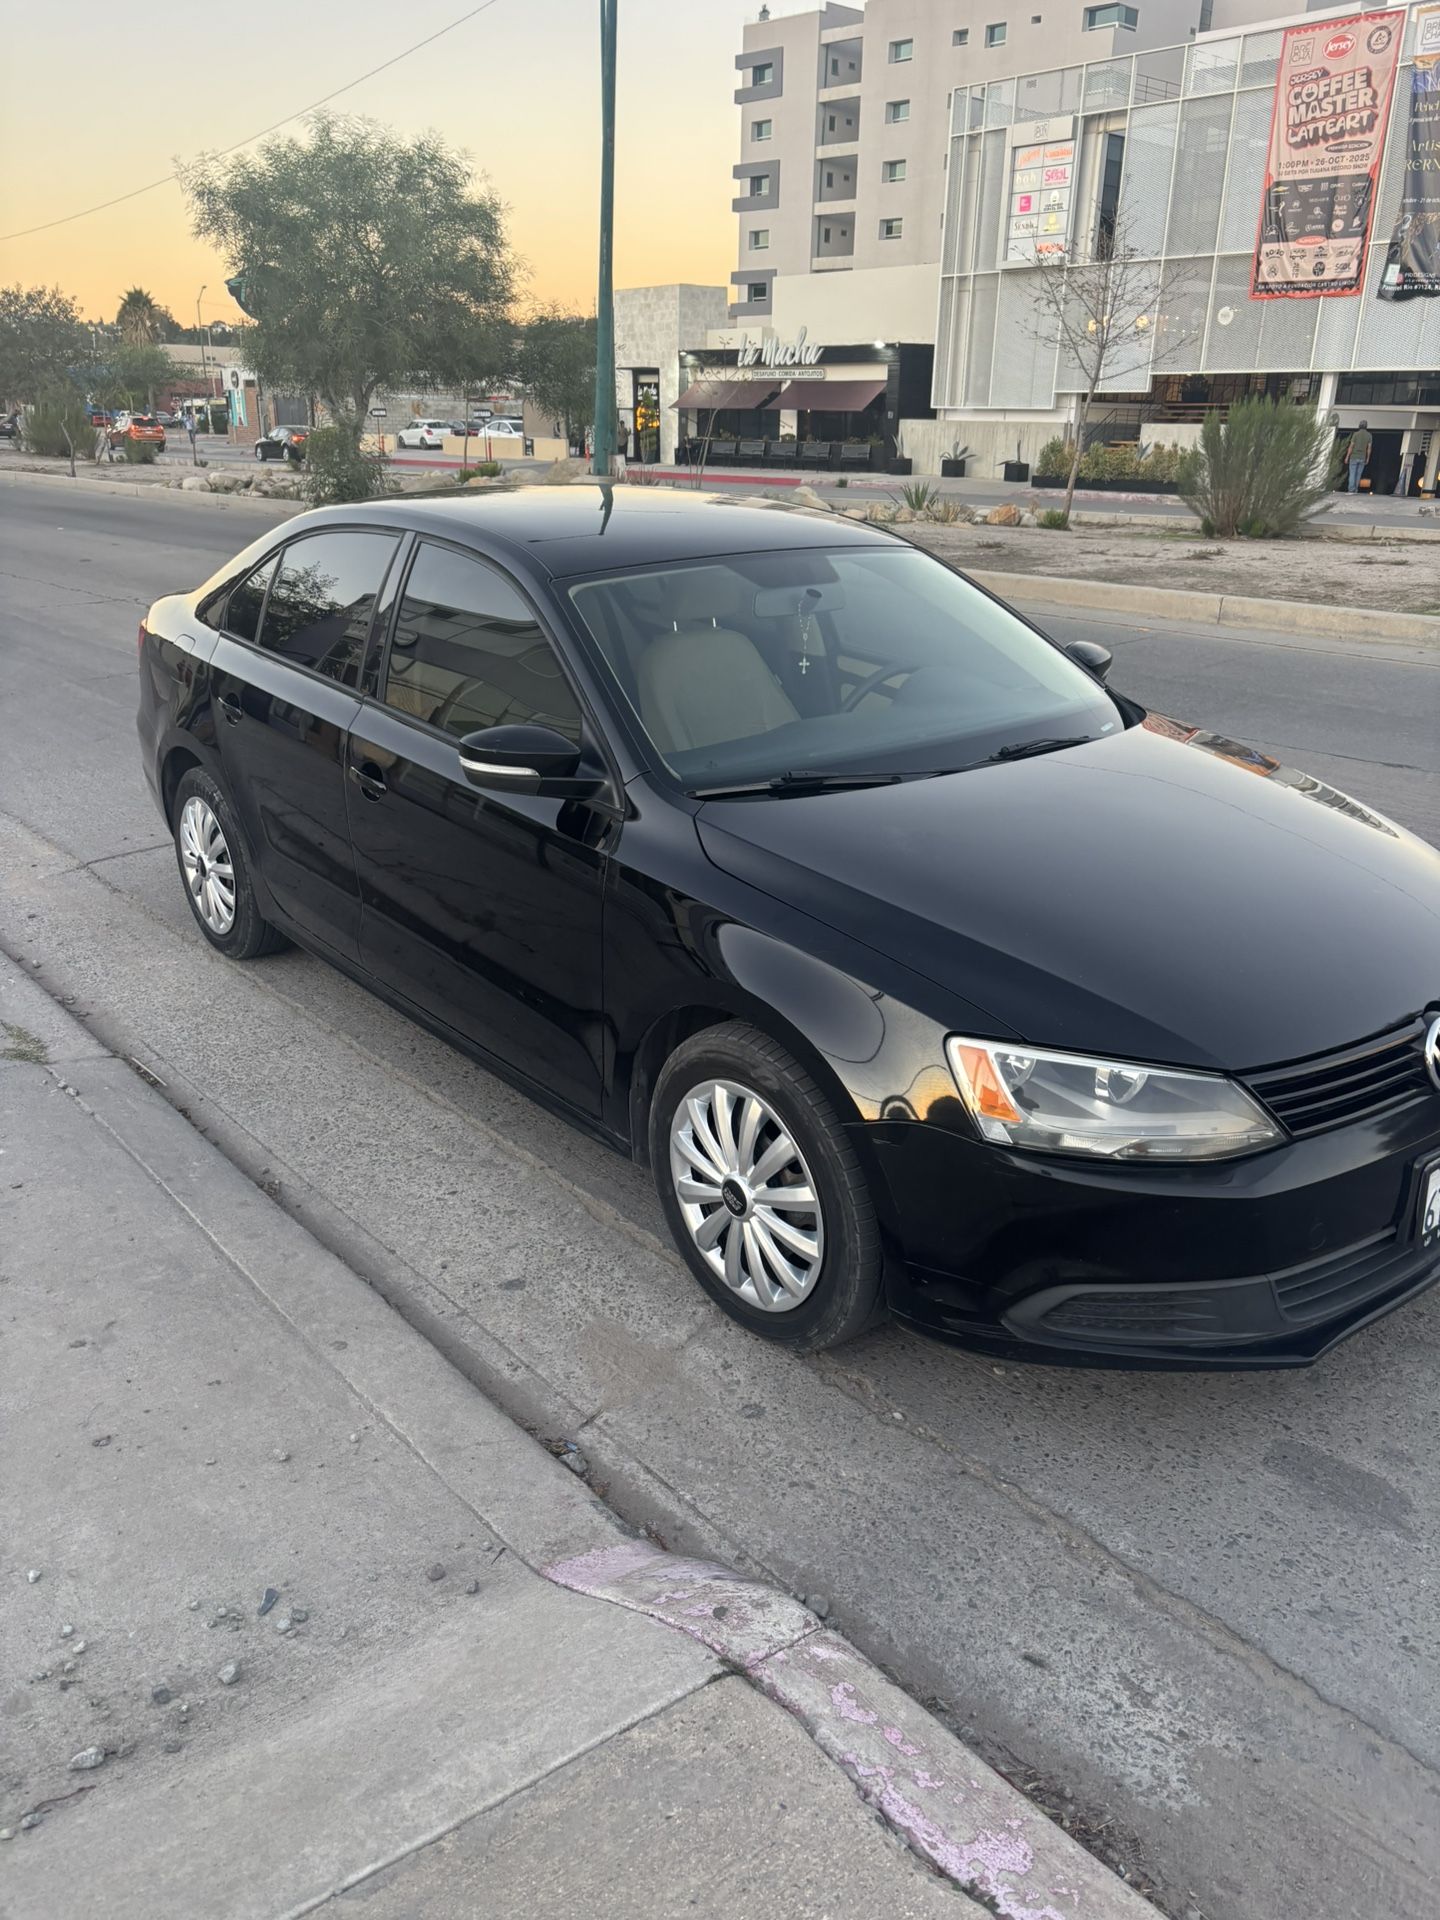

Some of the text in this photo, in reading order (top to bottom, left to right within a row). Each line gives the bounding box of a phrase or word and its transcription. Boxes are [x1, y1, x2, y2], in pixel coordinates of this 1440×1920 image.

[1289, 69, 1368, 105] COFFEE
[1290, 69, 1324, 84] JERSEY
[1288, 87, 1373, 126] MASTER
[1278, 160, 1309, 169] 1:00PM
[737, 333, 761, 368] La
